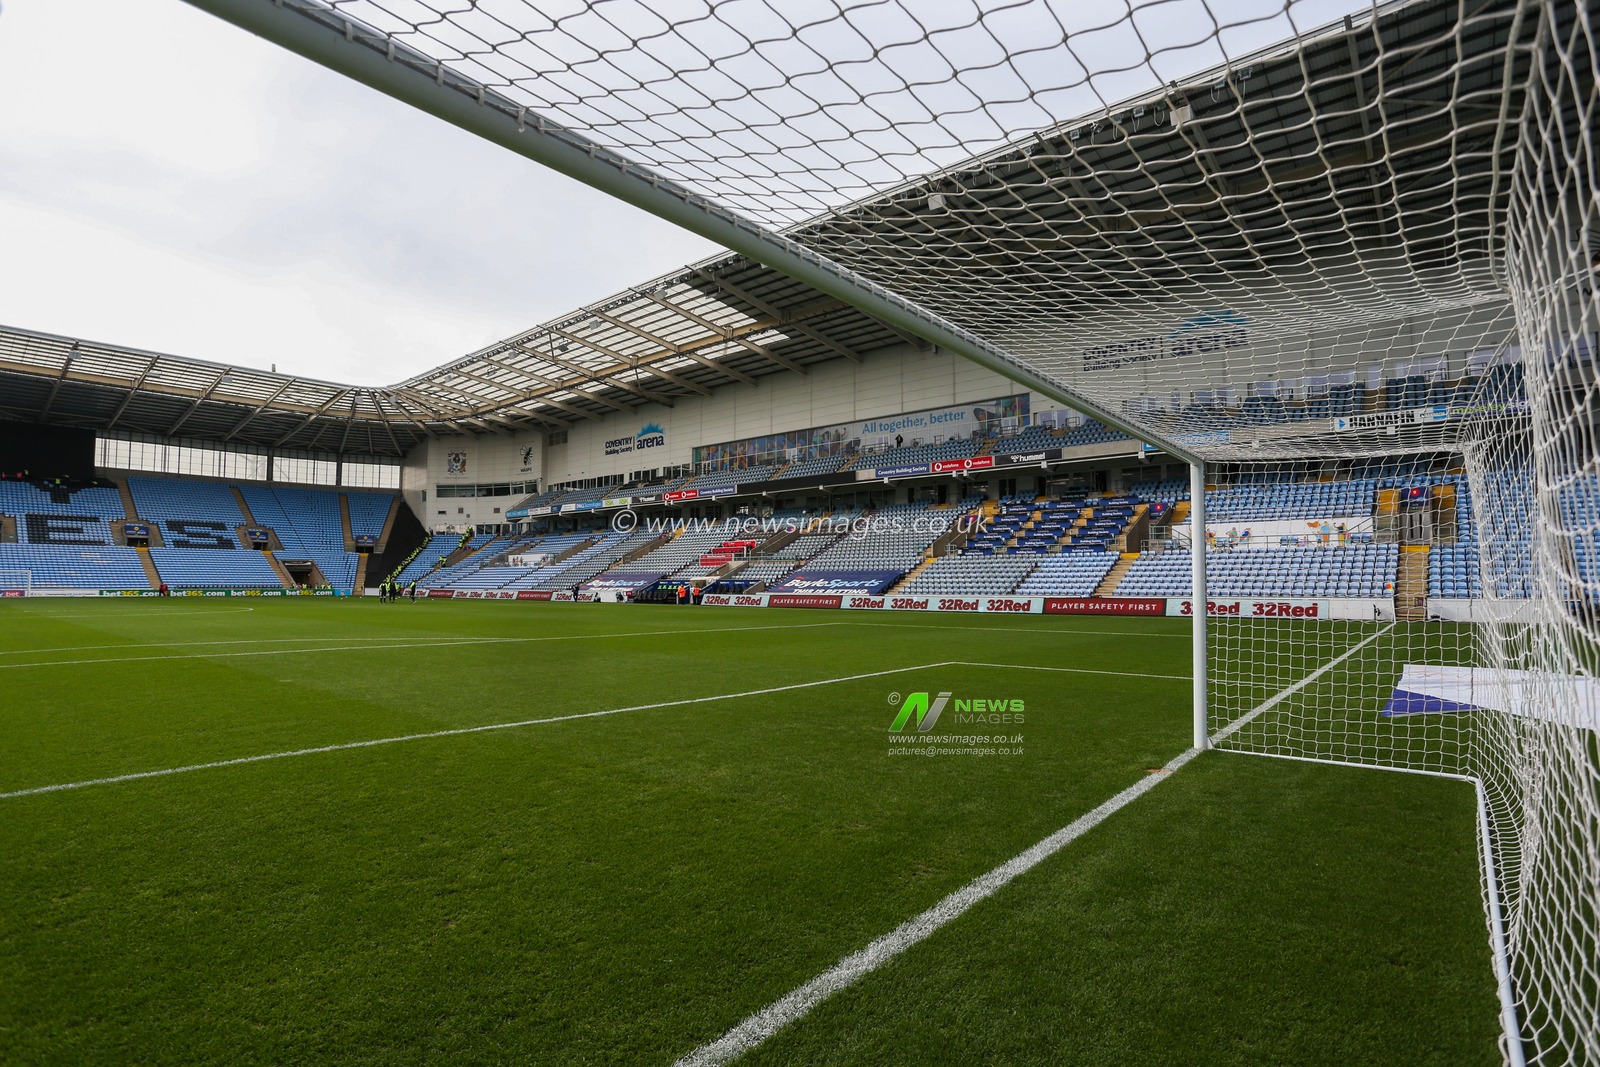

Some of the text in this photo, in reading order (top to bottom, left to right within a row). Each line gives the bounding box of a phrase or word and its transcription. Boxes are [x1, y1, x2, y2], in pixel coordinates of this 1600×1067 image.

[862, 411, 966, 434] All together, better
[605, 437, 633, 448] COVENTRY
[636, 435, 664, 450] arena
[1020, 452, 1046, 461] hummel
[784, 578, 883, 588] BoyleSports
[704, 596, 762, 605] 32Red 32Red
[849, 598, 1031, 612] 32Red 32Red 32Red 32Red
[1051, 602, 1158, 611] PLAYER SAFETY FIRST
[1252, 603, 1318, 617] 32Red
